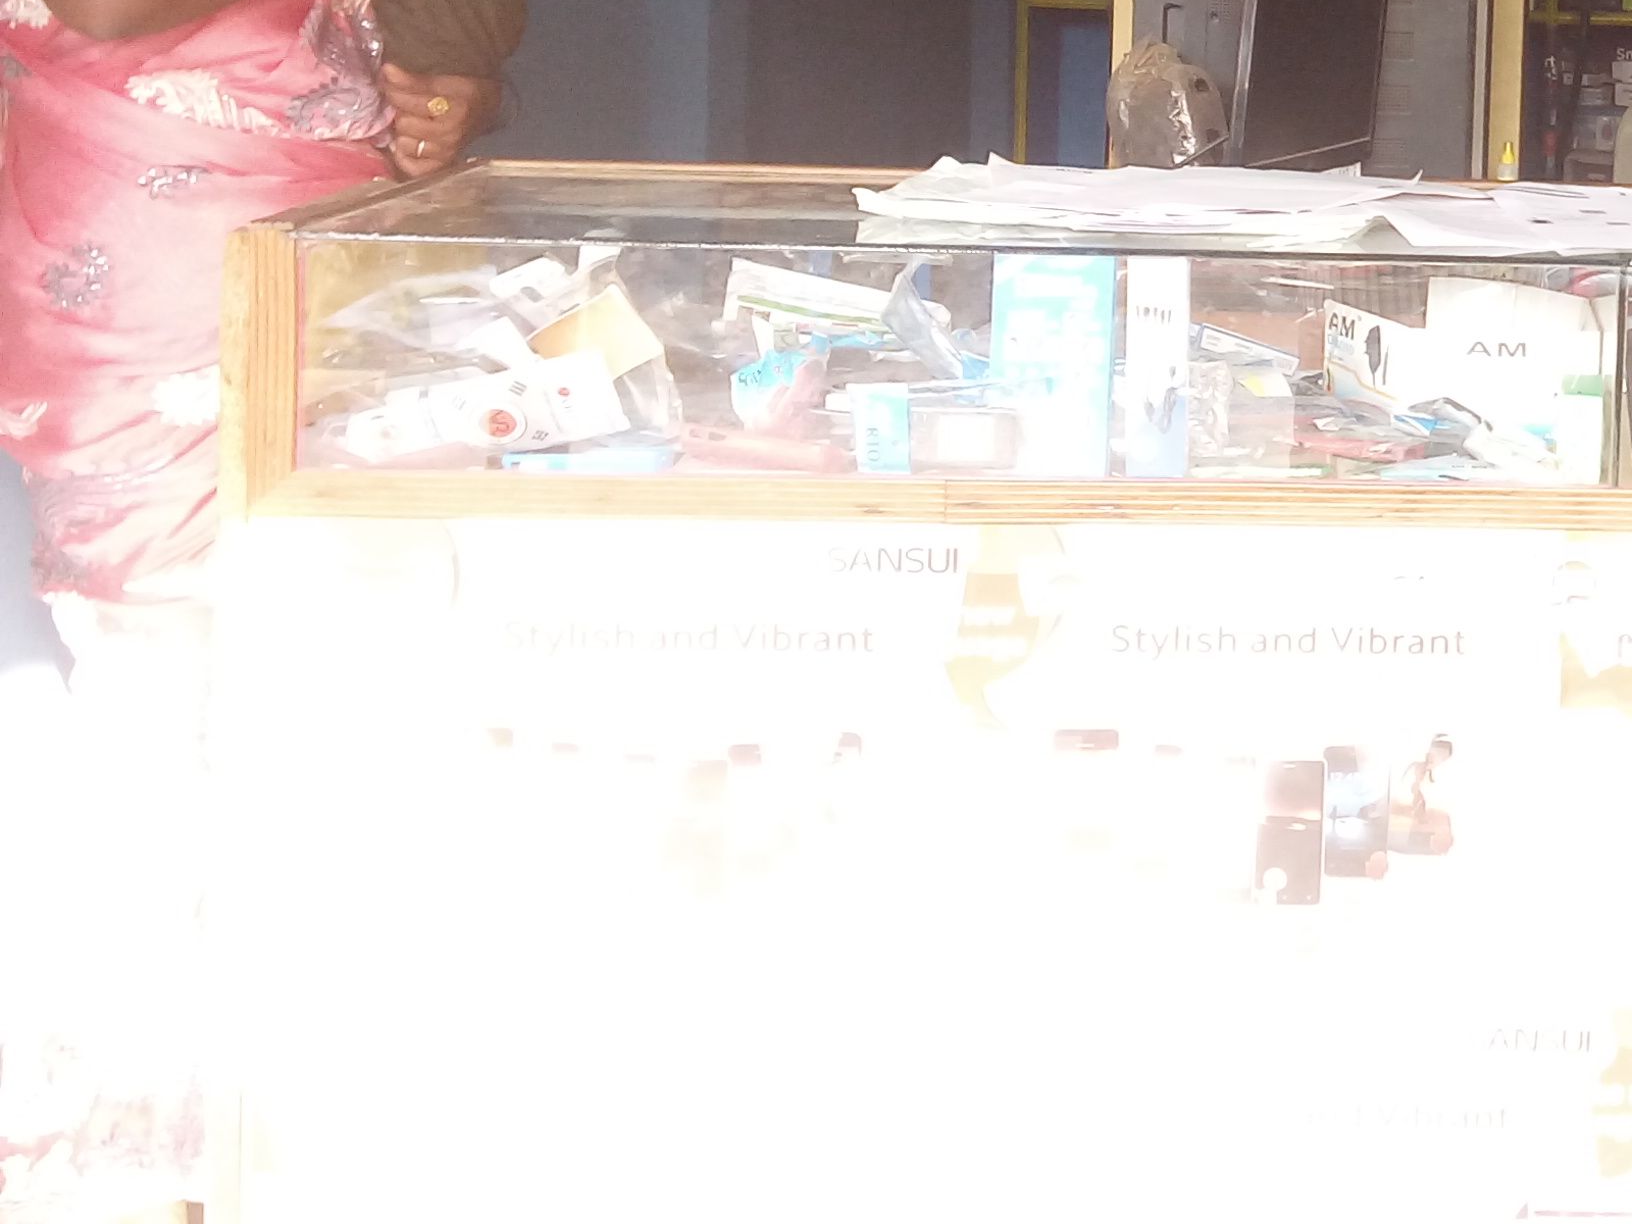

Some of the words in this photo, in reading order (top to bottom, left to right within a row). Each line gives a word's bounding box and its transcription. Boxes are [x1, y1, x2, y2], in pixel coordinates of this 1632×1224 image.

[1328, 311, 1356, 341] AM
[1466, 341, 1527, 358] AM
[827, 546, 960, 575] SANSUI
[650, 622, 718, 653] and
[733, 623, 875, 653] Vibrant
[1111, 624, 1238, 661] Stylish
[1249, 626, 1317, 655] and
[1330, 626, 1465, 656] Vibrant
